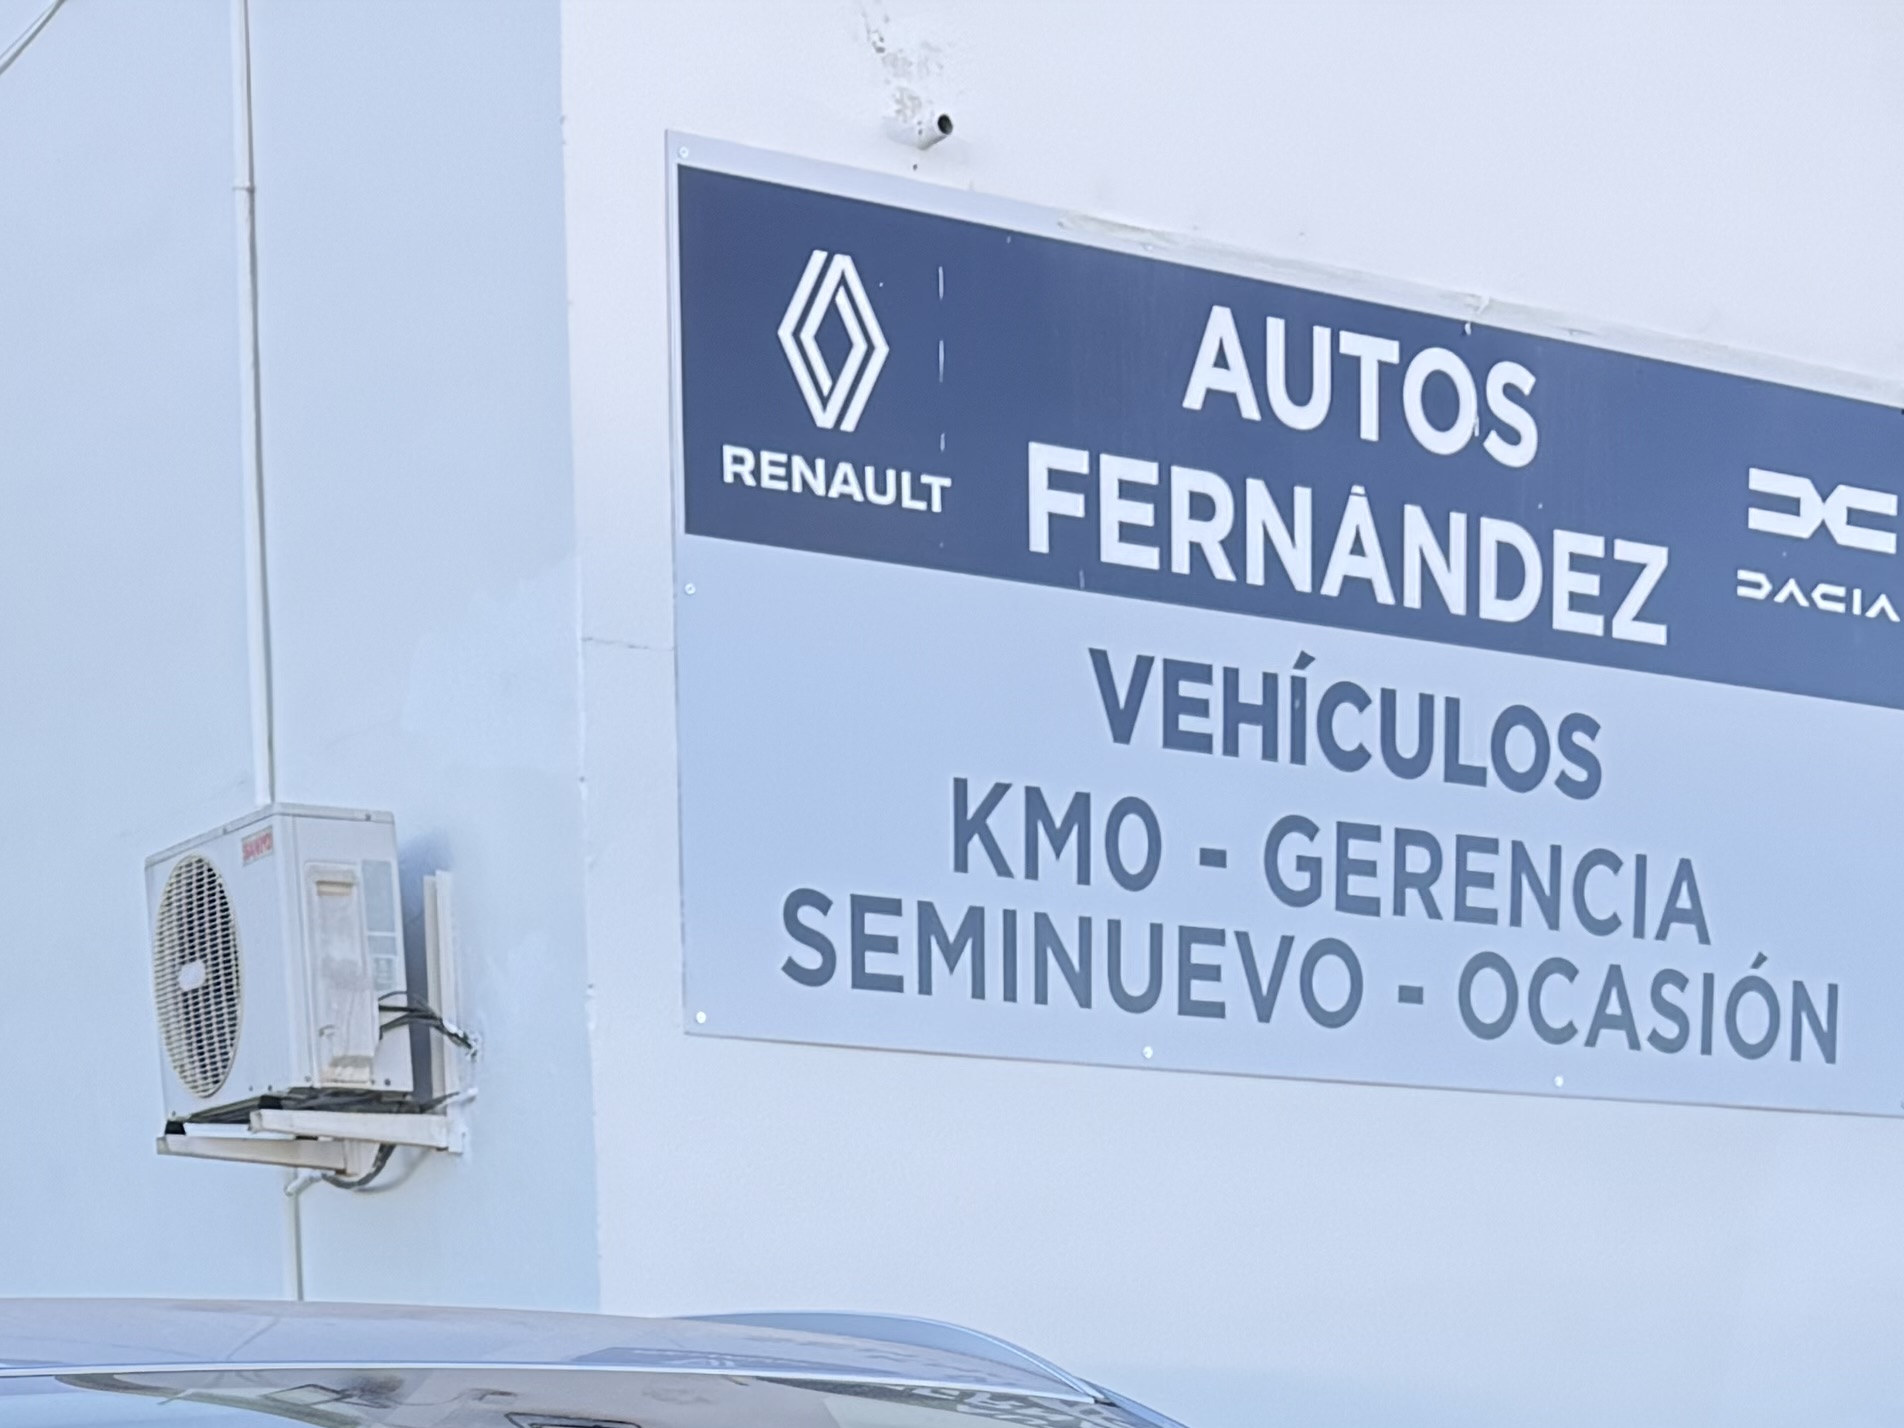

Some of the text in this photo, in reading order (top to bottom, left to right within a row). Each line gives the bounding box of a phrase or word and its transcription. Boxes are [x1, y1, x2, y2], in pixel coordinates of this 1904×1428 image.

[1182, 305, 1538, 468] AUTOS
[722, 445, 951, 512] RENAULT
[1028, 441, 1669, 646] FERNÁNDEZ
[1737, 570, 1900, 622] DACIA
[1088, 648, 1602, 800] VEHÍCULOS
[1264, 815, 1711, 946] GERENCIA
[781, 888, 1364, 1029] SEMINUEVO
[1459, 952, 1839, 1065] OCASIÓN
